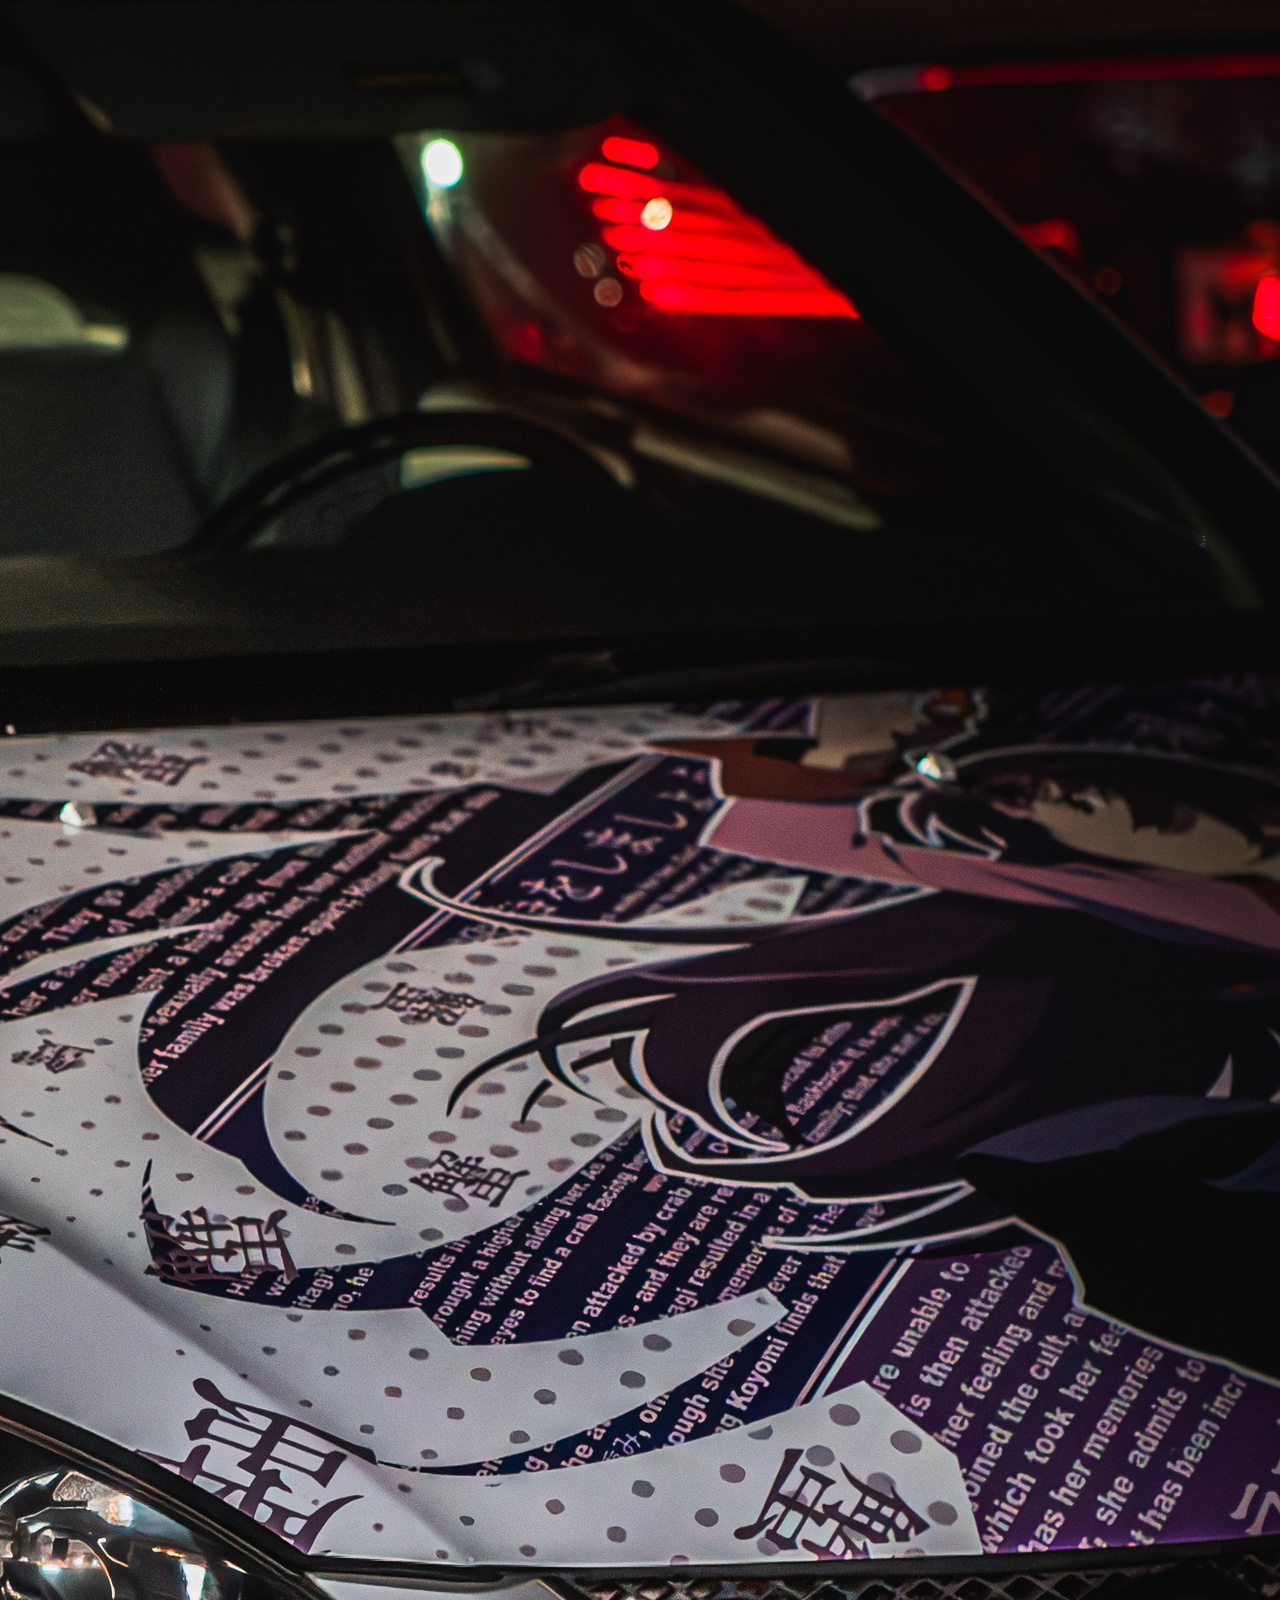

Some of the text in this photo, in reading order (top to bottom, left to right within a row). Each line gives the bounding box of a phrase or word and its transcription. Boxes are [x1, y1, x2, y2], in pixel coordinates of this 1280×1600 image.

[471, 1259, 490, 1271] a
[478, 1250, 533, 1307] without
[514, 1288, 540, 1307] to
[527, 1257, 563, 1288] find
[554, 1246, 572, 1258] a
[564, 1213, 599, 1245] crab
[582, 1242, 646, 1318] attacked
[634, 1221, 667, 1243] by
[655, 1187, 693, 1221] crab
[635, 1268, 669, 1303] and
[655, 1231, 700, 1268] they
[688, 1205, 719, 1232] are
[687, 1219, 747, 1288] resulted
[732, 1204, 761, 1221] in
[725, 1335, 789, 1412] Koyomi
[774, 1292, 819, 1336] finds
[807, 1256, 847, 1291] that
[890, 1287, 952, 1358] unable
[941, 1261, 970, 1282] to
[961, 1324, 1032, 1400] feeling
[1017, 1277, 1056, 1320] and
[905, 1394, 931, 1418] is
[919, 1336, 970, 1387] then
[997, 1382, 1039, 1423] the
[1029, 1333, 1078, 1381] cult,
[982, 1472, 1038, 1554] which
[1023, 1406, 1076, 1465] took
[1058, 1359, 1102, 1402] her
[1048, 1458, 1091, 1507] her
[1082, 1347, 1163, 1460] memories
[1096, 1352, 1206, 1526] she admits to
[1137, 1479, 1183, 1532] has
[1166, 1419, 1221, 1479] been
